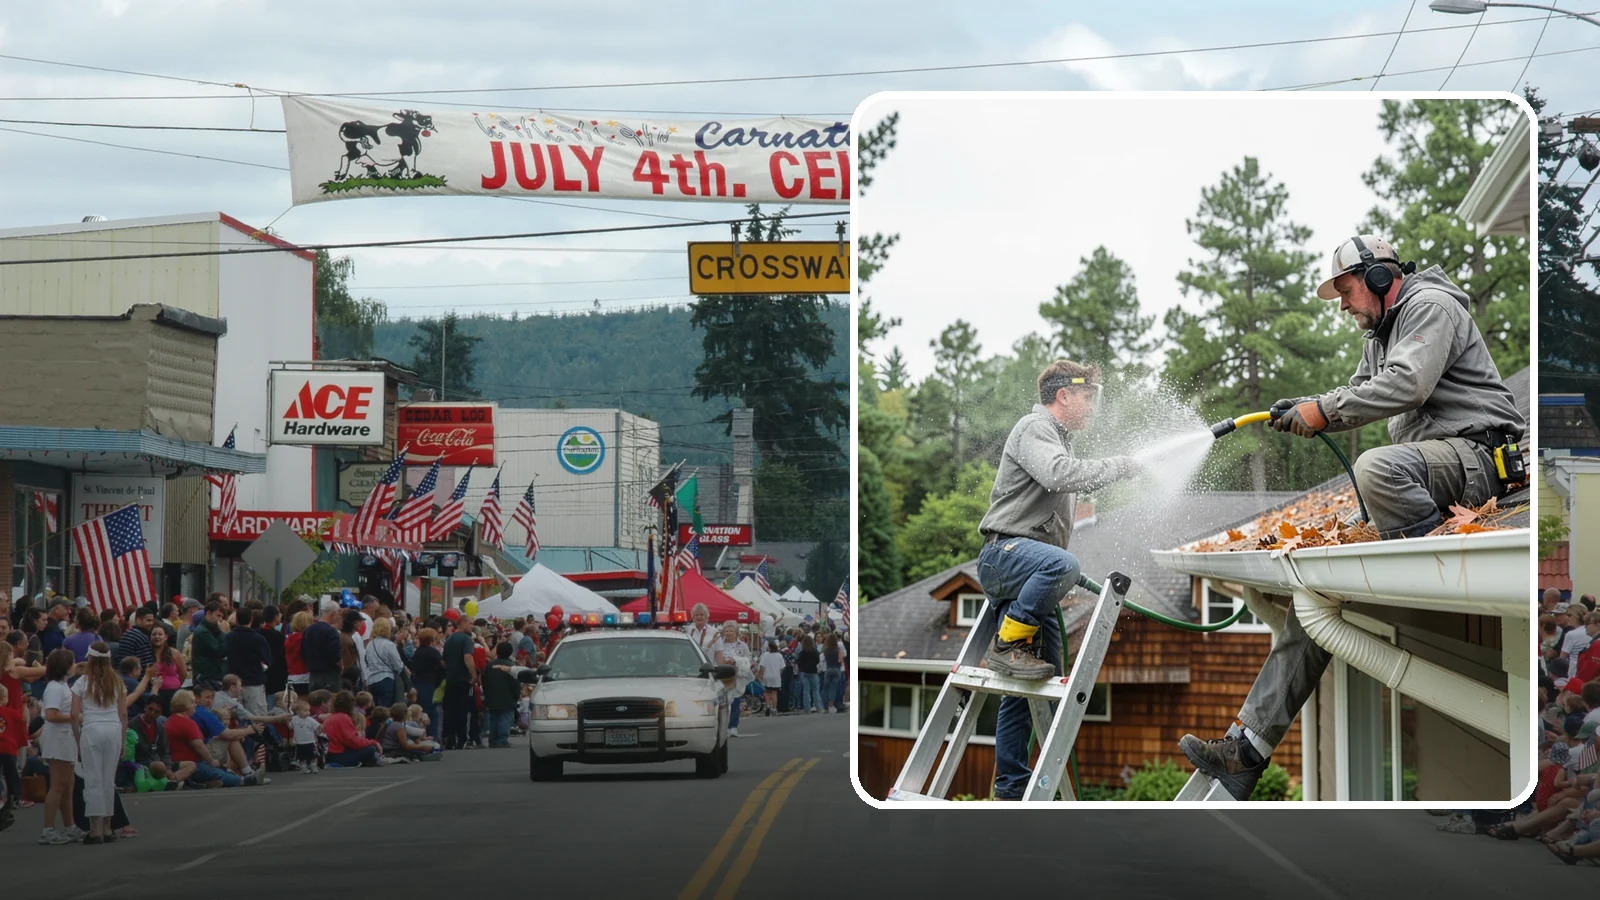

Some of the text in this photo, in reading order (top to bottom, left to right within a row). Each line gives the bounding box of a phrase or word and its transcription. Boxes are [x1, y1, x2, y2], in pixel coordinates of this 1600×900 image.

[695, 121, 850, 150] Carnat
[481, 141, 605, 192] JULY
[632, 150, 746, 197] 4th.
[697, 254, 850, 280] CROSSWA
[283, 380, 373, 420] ACE
[405, 409, 485, 422] CEDAR LOG
[283, 421, 371, 437] Hardware
[416, 428, 477, 446] Coca-Cola
[353, 467, 387, 480] Simpl
[96, 485, 122, 495] Vincent
[126, 486, 136, 494] de
[138, 486, 155, 495] Paul
[81, 503, 154, 521] THT
[213, 515, 330, 536] HARDARE
[688, 526, 741, 535] CRNATION
[699, 535, 730, 543] GLASS
